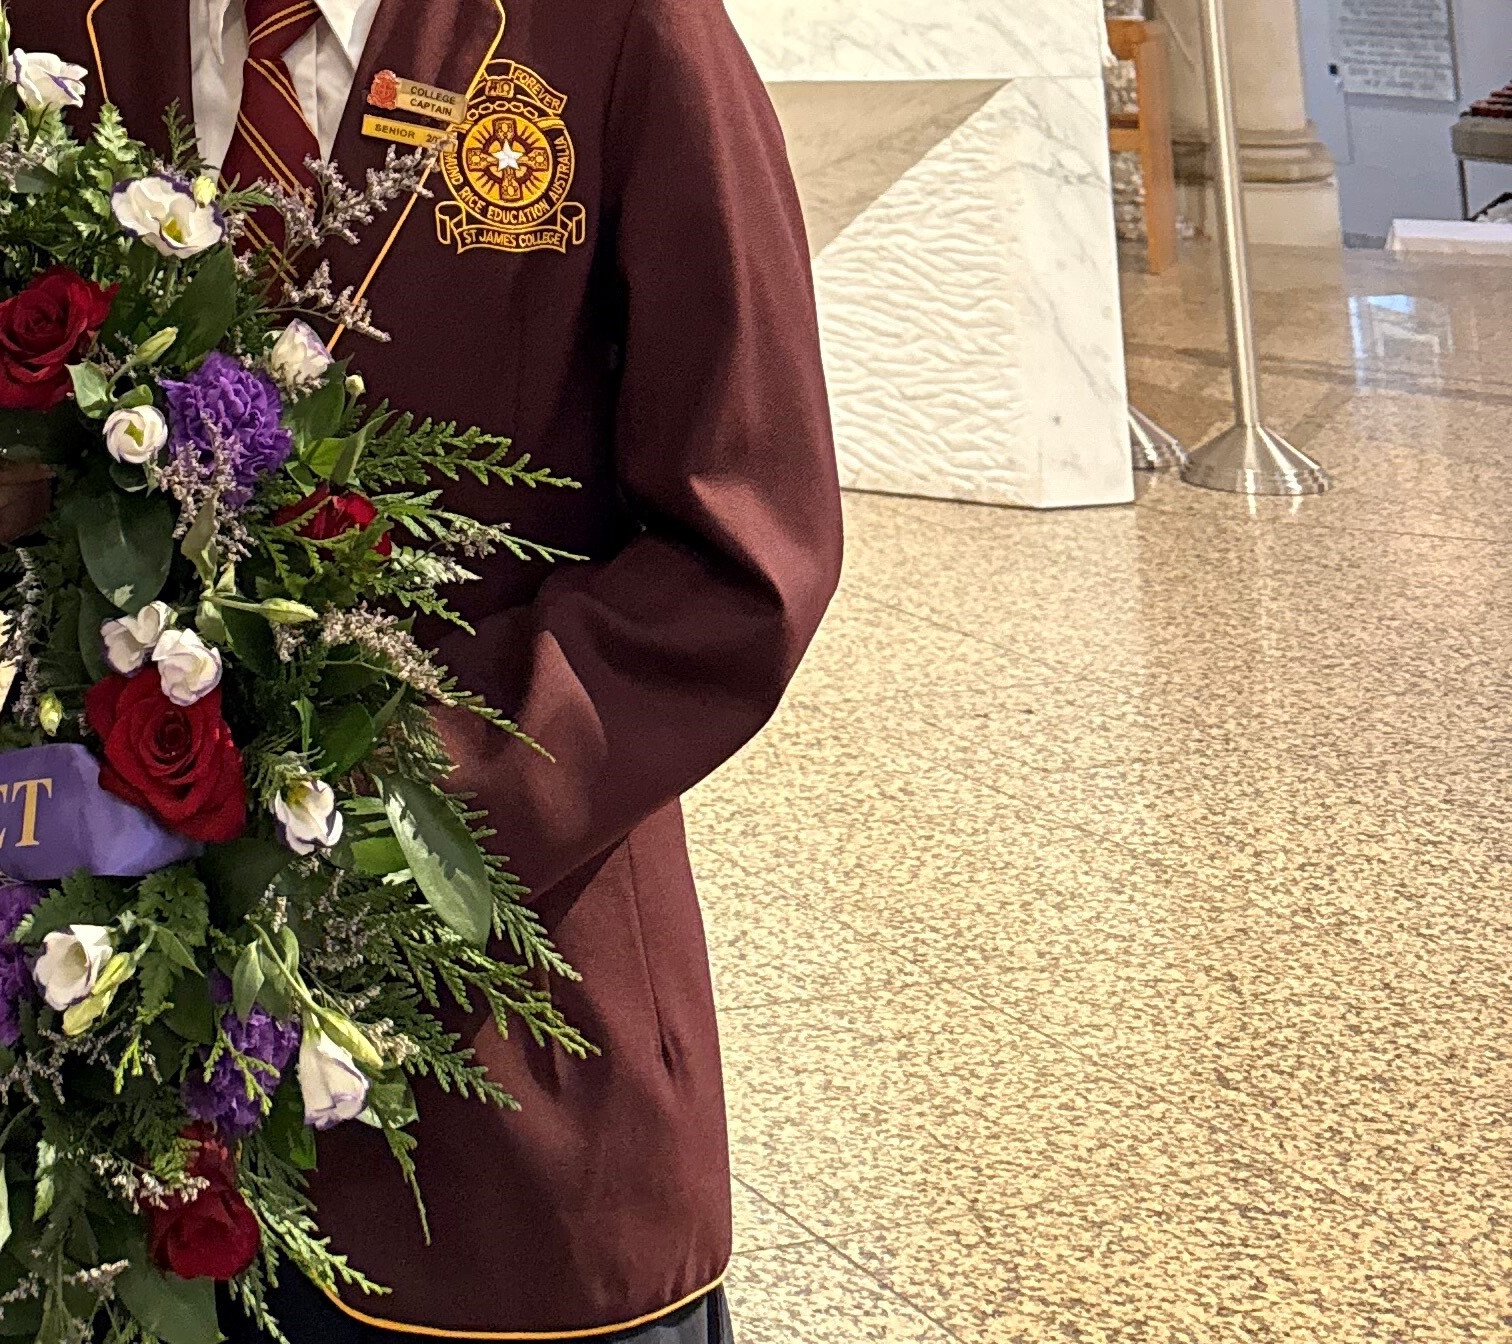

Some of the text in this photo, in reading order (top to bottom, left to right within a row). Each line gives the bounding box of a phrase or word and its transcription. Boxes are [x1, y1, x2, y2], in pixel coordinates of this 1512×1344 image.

[410, 86, 456, 104] COLLEGE
[514, 69, 560, 110] FOREVER
[410, 98, 452, 116] CAPTAIN
[374, 123, 415, 139] SENIOR
[458, 186, 486, 213] RICE
[487, 198, 550, 223] EDUCATION
[549, 135, 570, 203] AUSTRALIA
[463, 230, 561, 247] ST JAMES COLLEGE
